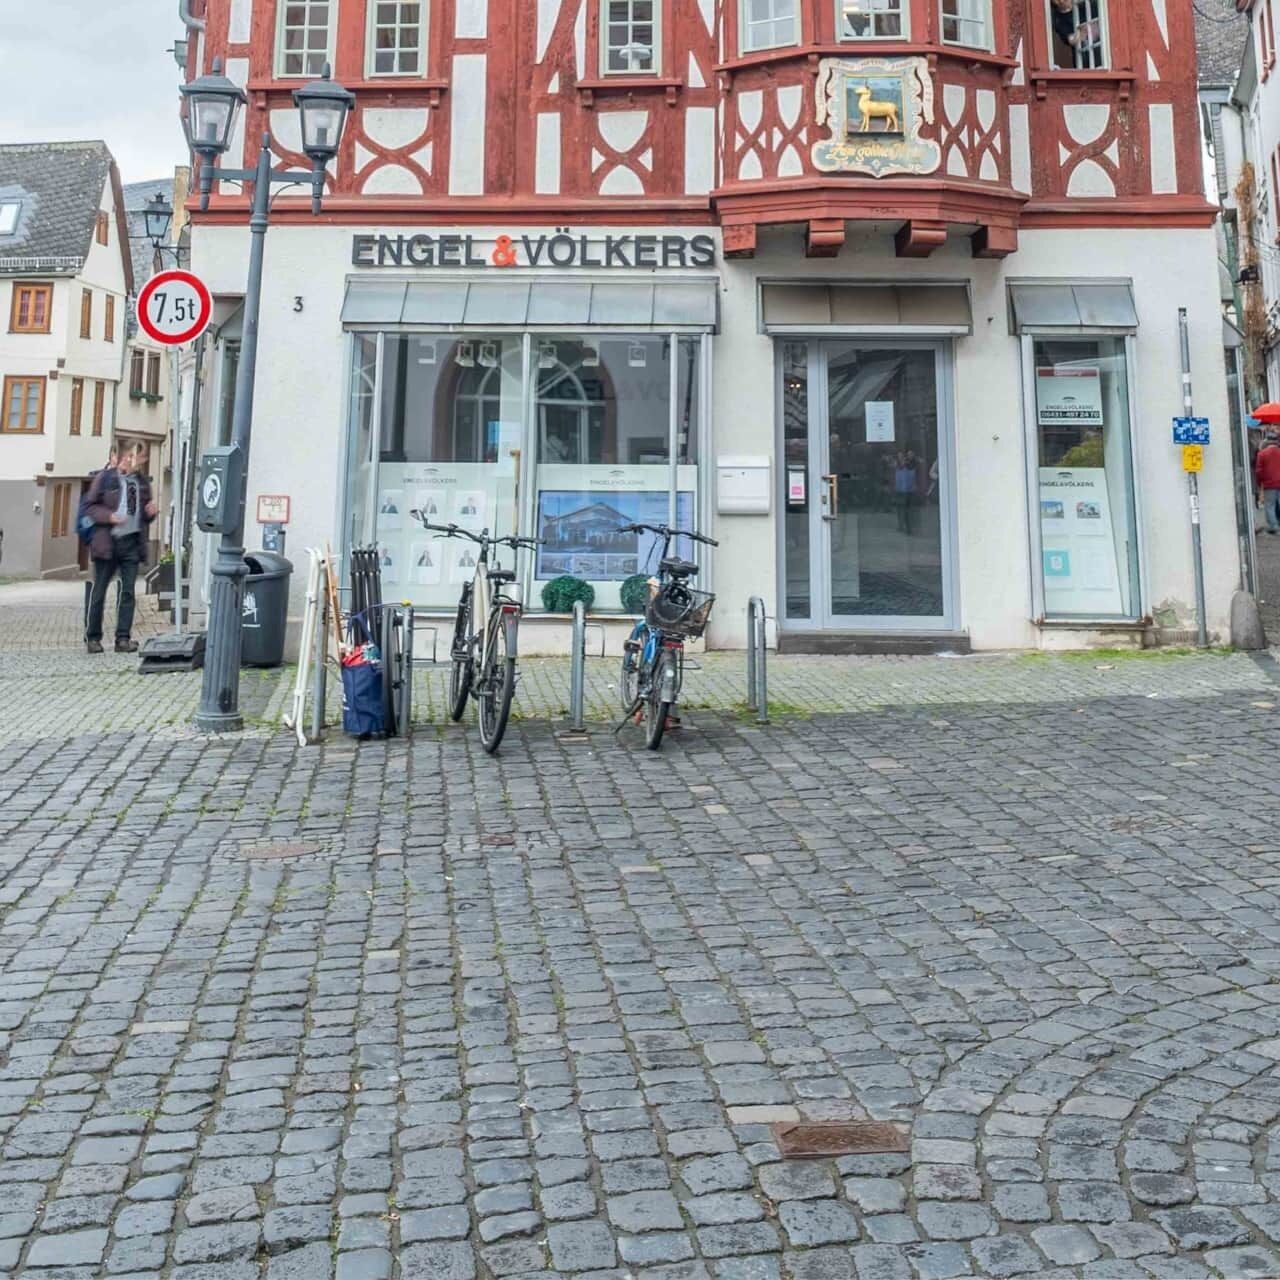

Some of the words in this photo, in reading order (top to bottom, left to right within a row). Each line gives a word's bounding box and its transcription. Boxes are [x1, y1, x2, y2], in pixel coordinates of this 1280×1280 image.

[352, 235, 486, 266] ENGEL
[491, 235, 518, 266] &
[521, 227, 716, 267] VÖLKERS
[293, 296, 304, 313] 3
